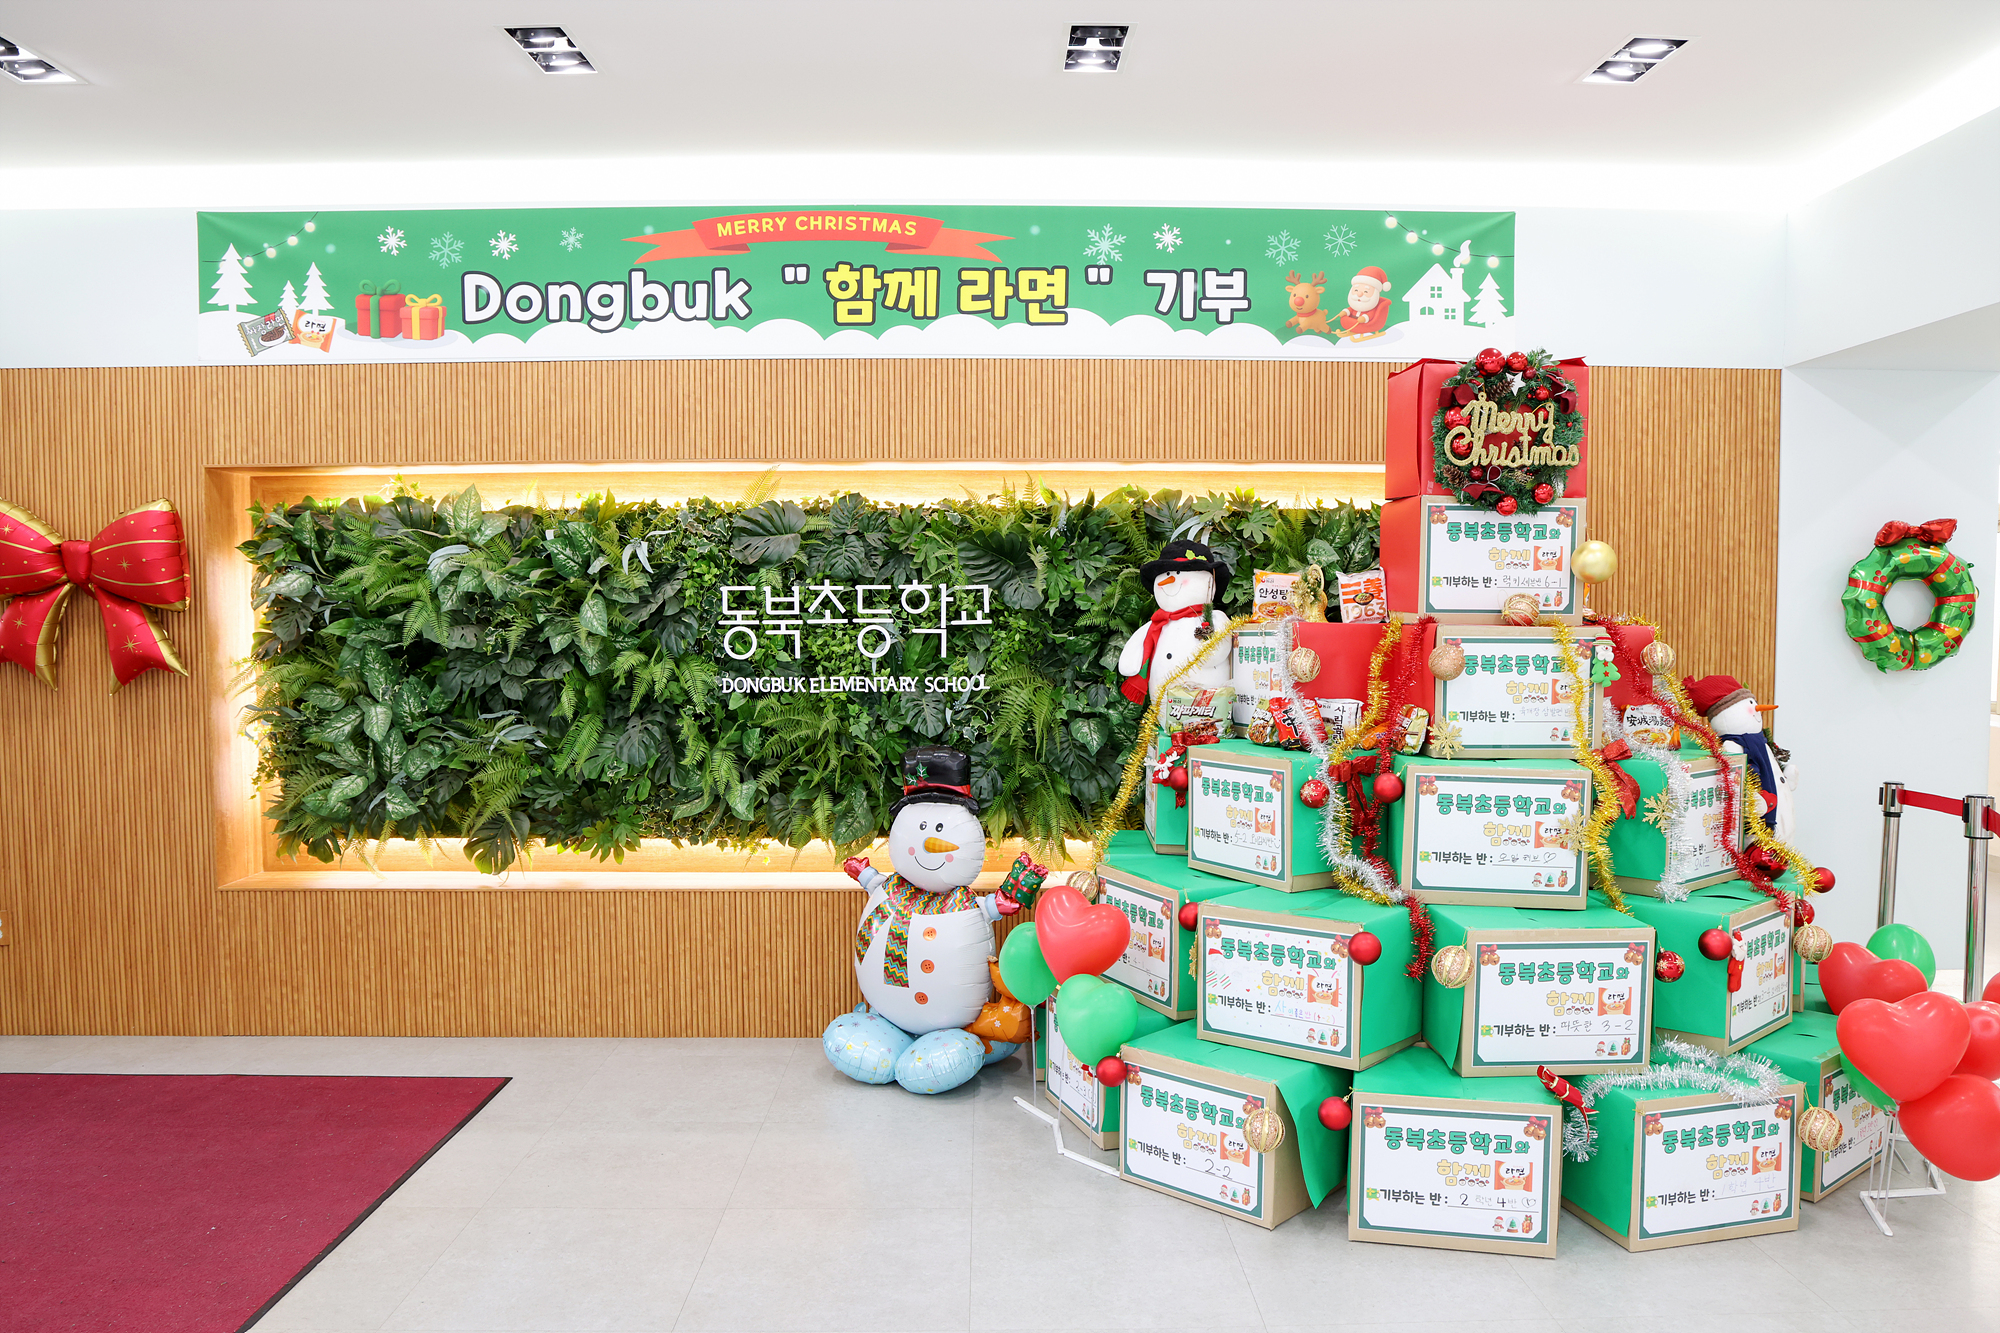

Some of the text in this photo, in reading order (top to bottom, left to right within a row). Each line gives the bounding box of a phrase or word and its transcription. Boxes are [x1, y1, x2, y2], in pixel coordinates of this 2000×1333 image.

[716, 215, 917, 237] MERRY CHRISTMAS
[460, 267, 752, 333] Dongbuk
[823, 260, 940, 327] 함께
[957, 263, 1070, 327] 라면
[1143, 265, 1252, 326] 기부
[304, 320, 327, 332] 라면
[1460, 394, 1556, 443] Merry
[1444, 425, 1580, 467] Christmas
[1446, 521, 1561, 543] 동북초등학교와
[1488, 546, 1531, 570] 함께
[1442, 575, 1480, 589] 기부하는
[1259, 588, 1290, 600] 안성탕
[718, 579, 993, 660] 동북초등학교
[1343, 602, 1387, 620] 1963
[1464, 653, 1572, 676] 동북초등학교
[721, 673, 991, 694] DONGBUK ELEMENTARY SCHOOL
[1505, 680, 1549, 704] 함께
[1169, 704, 1217, 720] 짜파게티
[1459, 710, 1497, 723] 기부하는
[1201, 776, 1274, 803] 동북초등학교와
[1226, 805, 1254, 828] 함께
[1436, 793, 1567, 817] 동북초등학교와
[1200, 827, 1221, 843] 기부하는
[1483, 821, 1532, 847] 함께
[1431, 851, 1473, 865] 기부하는
[1220, 937, 1337, 971] 동북초등학교와
[1745, 928, 1786, 961] 북초등학교와
[1261, 970, 1305, 997] 함께
[1498, 960, 1630, 986] 동북초등학교와
[1217, 995, 1254, 1013] 기부하는
[1546, 990, 1596, 1017] 함께
[1493, 1023, 1536, 1038] 기부하는
[1176, 1123, 1218, 1150] 함께
[1384, 1125, 1531, 1156] 동북초등학교와
[1661, 1119, 1781, 1155] 동북초등학교와
[1137, 1141, 1170, 1163] 기부하는
[1204, 1158, 1233, 1181] 2-2
[1436, 1159, 1492, 1187] 함께
[1705, 1151, 1750, 1180] 함께
[1379, 1189, 1426, 1206] 기부하는
[1657, 1190, 1697, 1207] 기부하는
